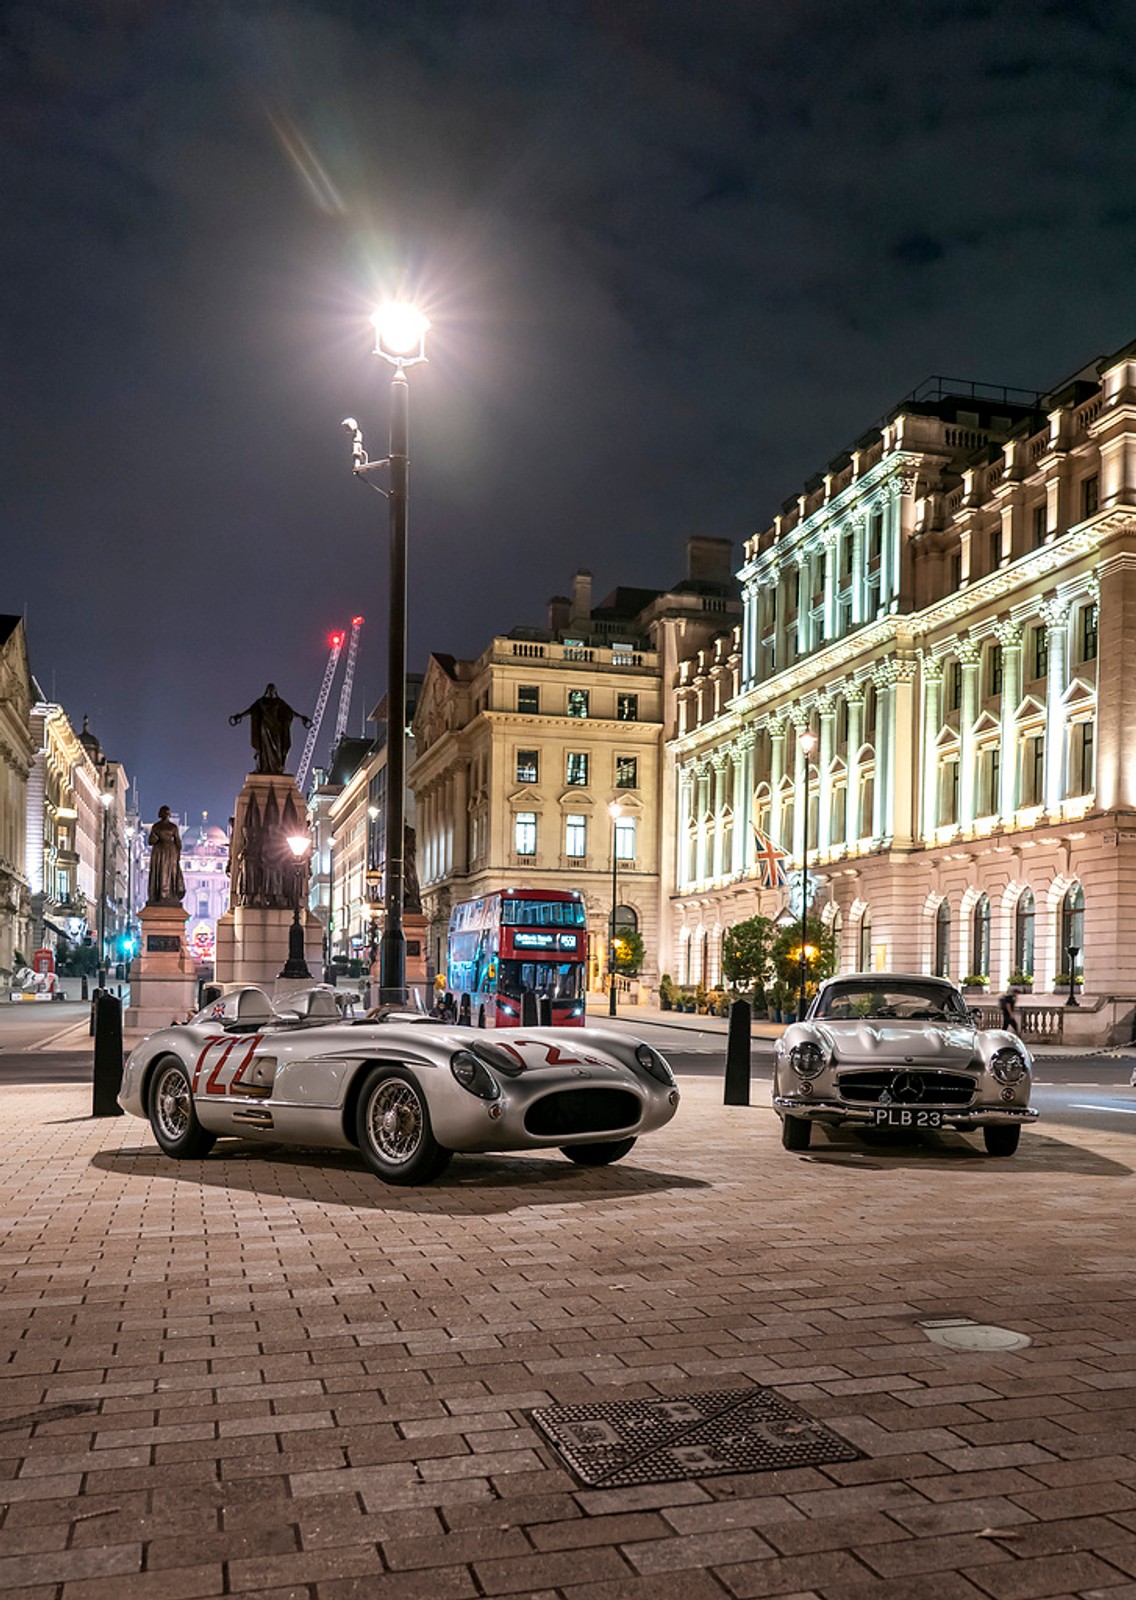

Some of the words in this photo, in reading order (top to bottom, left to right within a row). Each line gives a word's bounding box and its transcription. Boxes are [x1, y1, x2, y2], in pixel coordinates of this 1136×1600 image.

[192, 1034, 265, 1095] 722
[876, 1109, 912, 1126] PLB
[917, 1111, 941, 1127] 23
